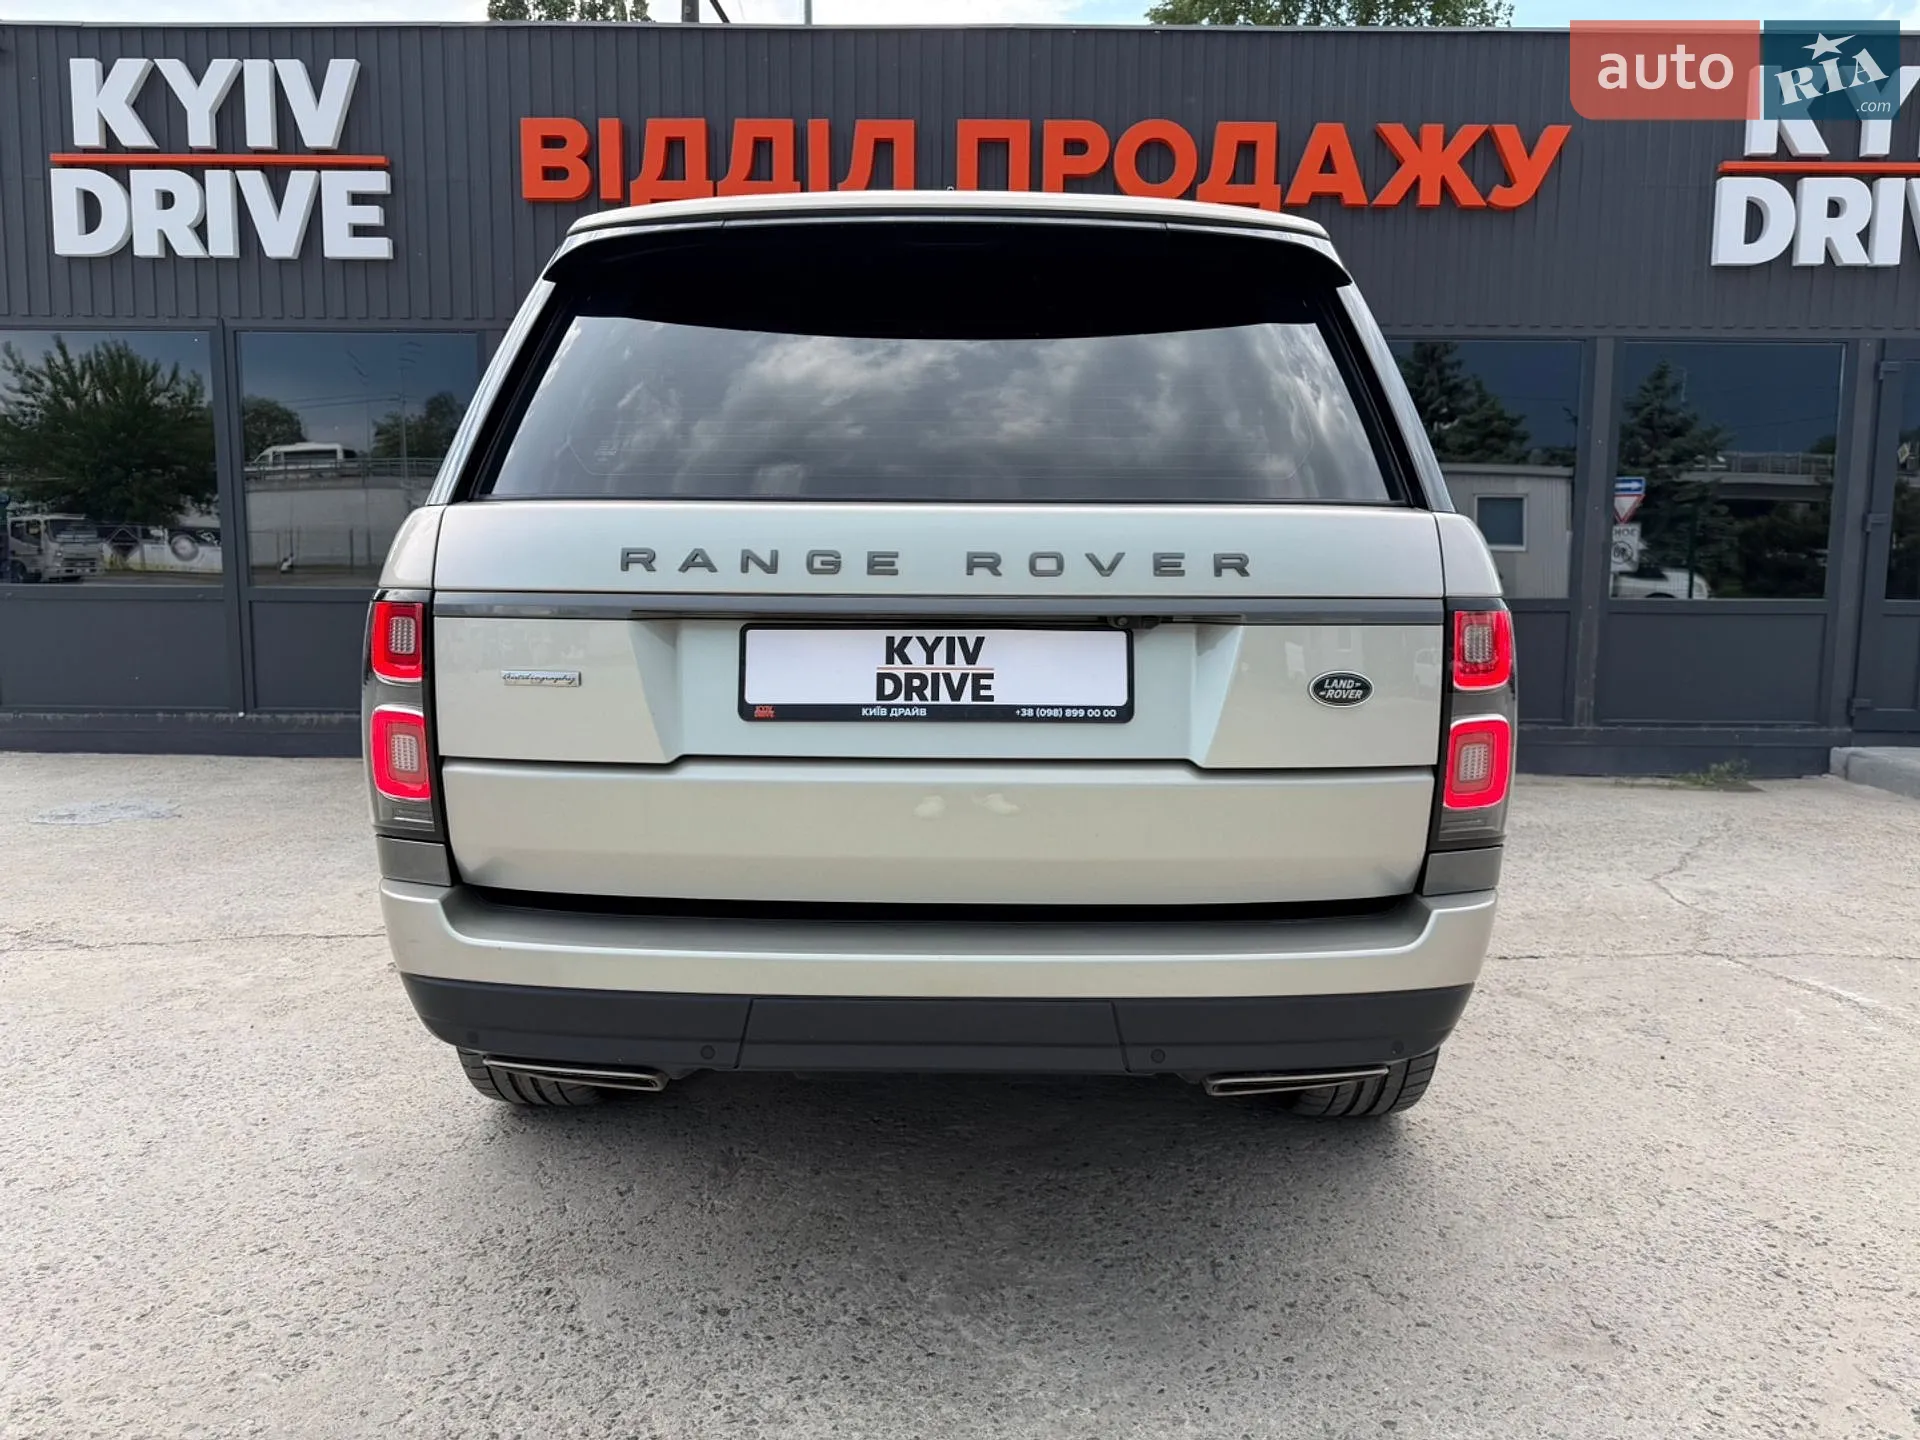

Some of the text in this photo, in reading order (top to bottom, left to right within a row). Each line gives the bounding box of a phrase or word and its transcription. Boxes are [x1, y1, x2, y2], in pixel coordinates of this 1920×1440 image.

[69, 58, 361, 150] KYIV
[1744, 64, 1920, 157] KY
[520, 117, 1572, 211] ВІДДІЛ ПРОДАЖУ
[50, 168, 394, 260] DRIVE
[1710, 176, 1920, 267] DRI
[620, 547, 1251, 577] RANGE ROVER
[885, 636, 985, 665] KYIV
[876, 672, 994, 702] DRIVE
[1324, 679, 1355, 689] LAND
[1325, 689, 1363, 699] ROVER
[861, 706, 927, 717] КИЇВ ДРАЙВ
[1016, 707, 1117, 718] +38 (098) 899 00 00
